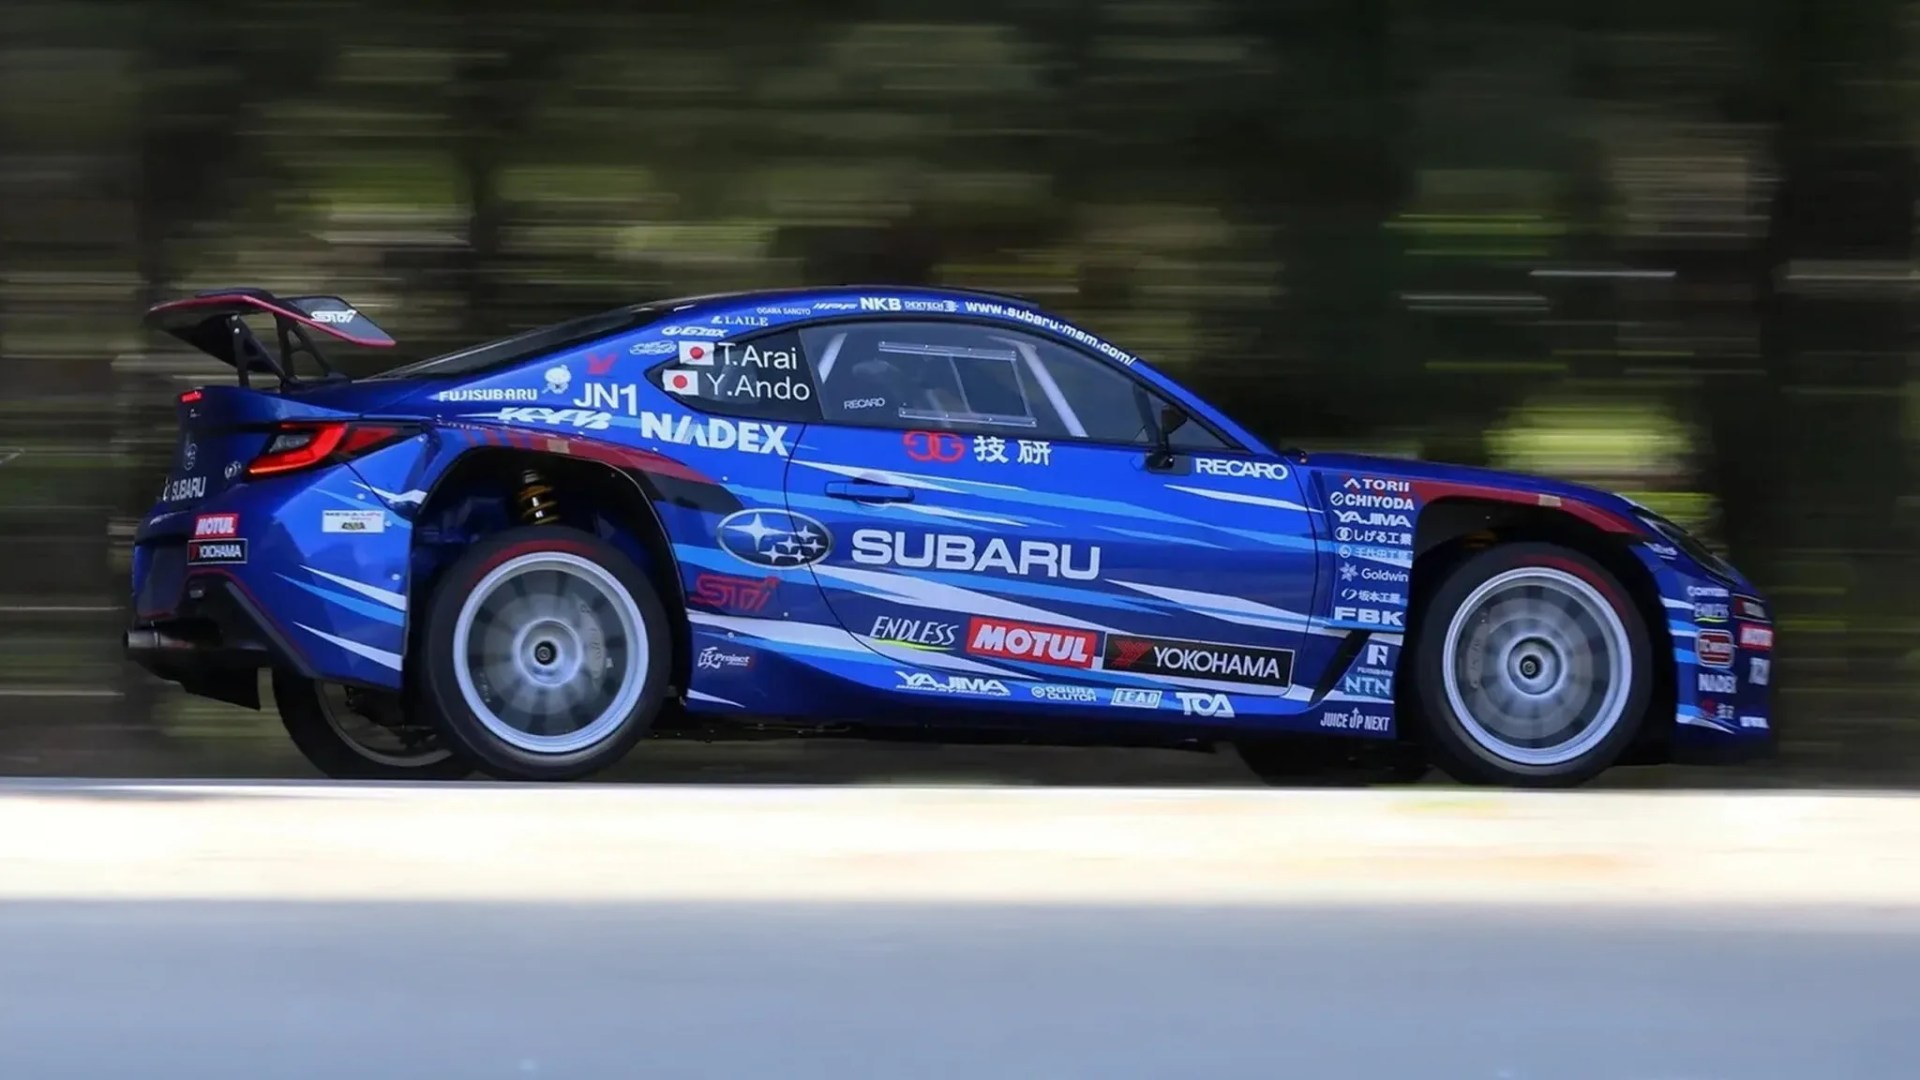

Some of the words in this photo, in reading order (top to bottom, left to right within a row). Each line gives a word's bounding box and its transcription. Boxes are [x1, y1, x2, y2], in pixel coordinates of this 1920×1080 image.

[859, 297, 902, 311] NKB
[725, 315, 769, 327] LAILE
[717, 341, 798, 370] T.Arai
[438, 388, 538, 402] FUJISUBARU
[706, 372, 810, 401] Y.Ando
[573, 382, 637, 416] JN1
[844, 397, 885, 410] RECARO
[641, 411, 790, 457] NADEX
[1195, 458, 1288, 480] RECARO
[171, 476, 207, 501] SUBARU
[1362, 478, 1410, 492] TORII
[1345, 493, 1415, 511] CHIYODA
[195, 517, 235, 535] MOTUL
[1333, 509, 1412, 528] YAJIMA
[852, 529, 1100, 580] SUBARU
[1361, 567, 1409, 582] Goldwin
[1334, 606, 1404, 626] FBK
[870, 616, 959, 646] ENDLESS
[972, 624, 1089, 663] MOTUL
[1153, 646, 1280, 679] YOKOHAMA
[895, 670, 1010, 693] YAJIMA
[1046, 685, 1095, 696] OGURA
[1345, 676, 1391, 696] NTN
[1047, 692, 1097, 702] CLUTCH
[1116, 691, 1158, 704] LEAD
[1320, 712, 1349, 728] JUICE
[1364, 715, 1390, 731] NEXT
